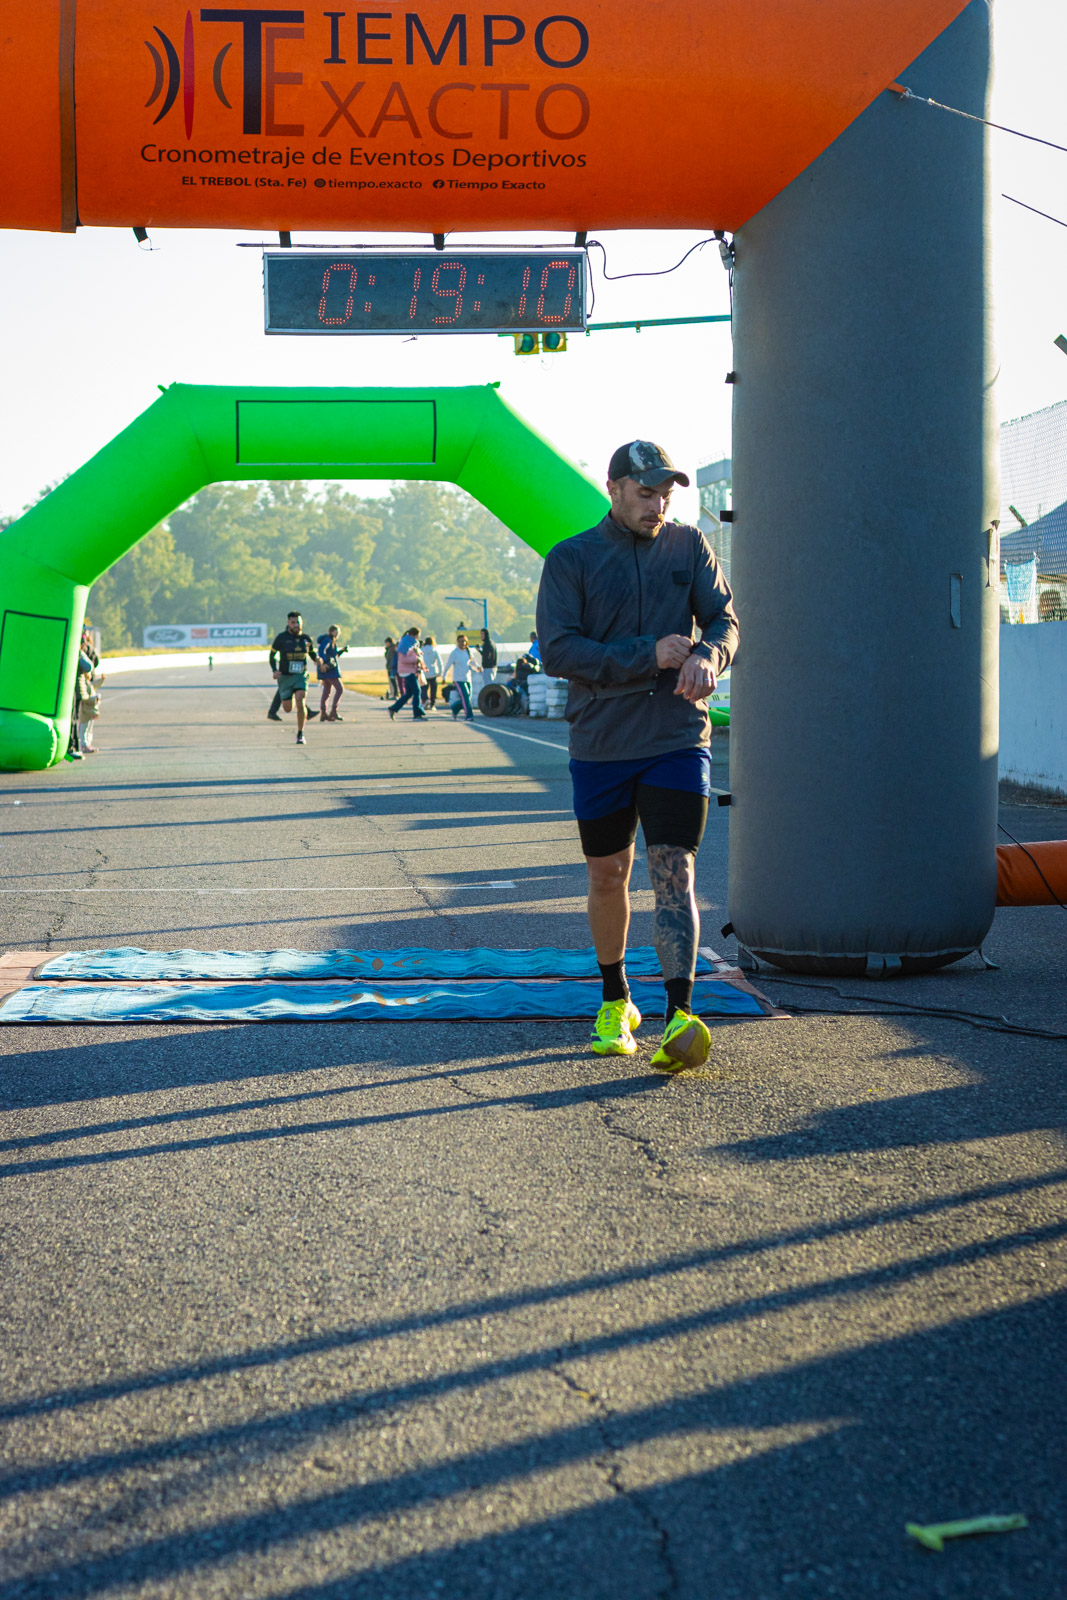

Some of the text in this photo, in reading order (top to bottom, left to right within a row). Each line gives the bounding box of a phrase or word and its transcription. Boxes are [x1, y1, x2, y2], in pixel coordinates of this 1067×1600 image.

[140, 143, 588, 172] Cronometraje de Eventos Deportivos
[181, 176, 546, 192] EL TREBOL (Sta. Fe) tiempo.exacto Tiempo Exacto
[154, 628, 258, 641] Ford LONG
